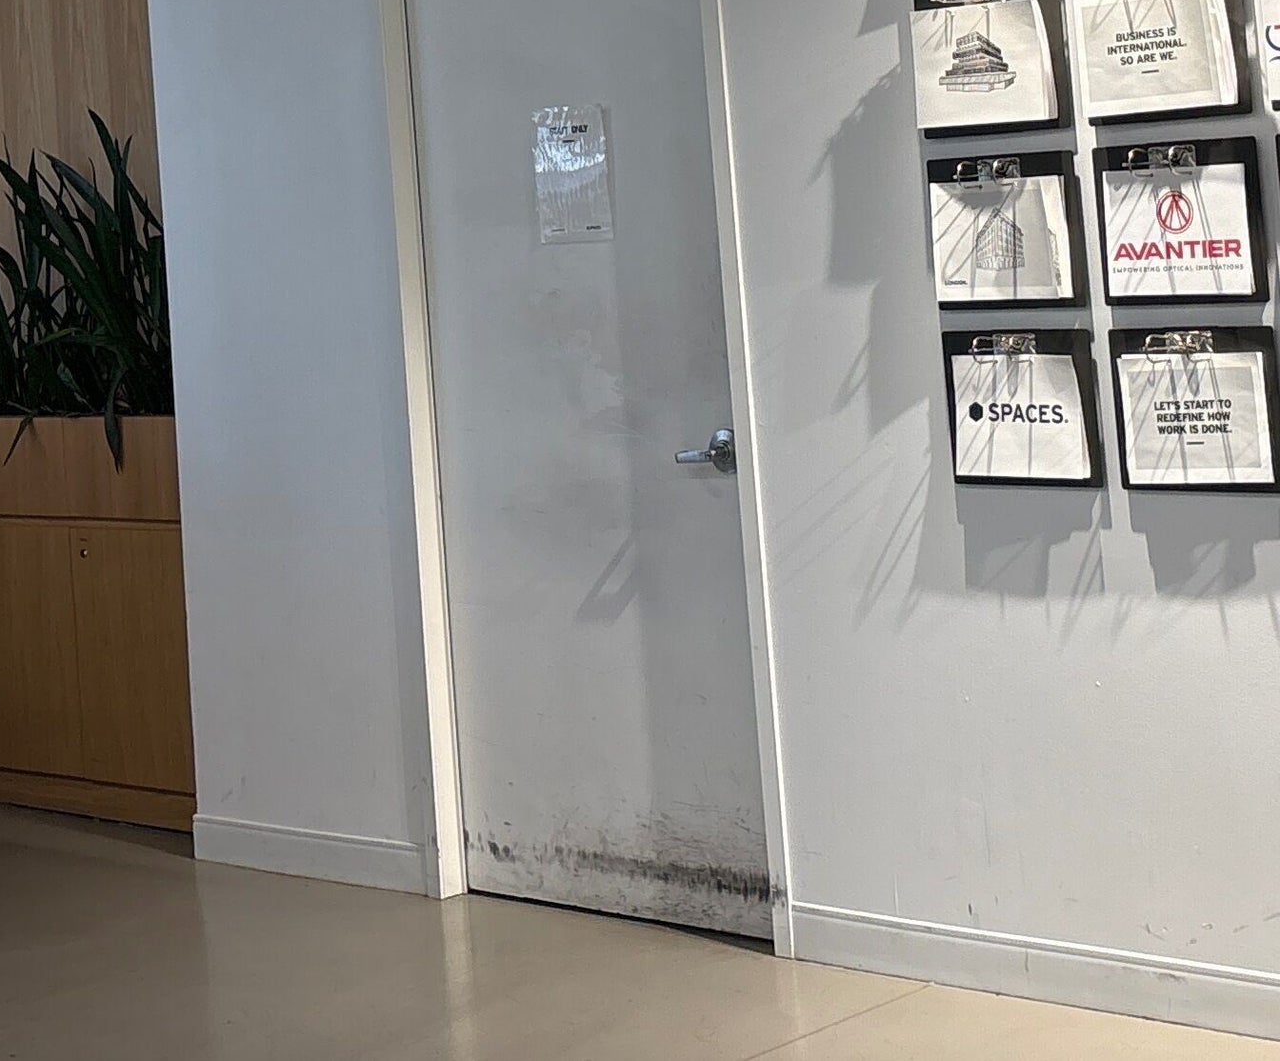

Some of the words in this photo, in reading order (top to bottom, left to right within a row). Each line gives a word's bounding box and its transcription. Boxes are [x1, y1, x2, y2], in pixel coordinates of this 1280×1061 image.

[1116, 29, 1164, 43] BUSINESS
[1167, 27, 1176, 37] IS
[1107, 38, 1187, 56] INTERNATIONAL.
[1120, 56, 1134, 66] SO
[1136, 53, 1157, 64] ARE
[1158, 50, 1178, 61] WE.
[1113, 239, 1242, 261] AVANTIER
[1163, 264, 1193, 272] OPTICAL
[1154, 400, 1180, 412] LET'S
[1184, 399, 1214, 410] START
[1218, 399, 1231, 409] TO
[988, 404, 1068, 424] SPACES.
[1156, 412, 1205, 423] REDEFINE
[1207, 411, 1231, 421] HOW
[1158, 424, 1185, 435] WORK
[1190, 424, 1198, 434] IS
[1202, 423, 1232, 434] DONE.
